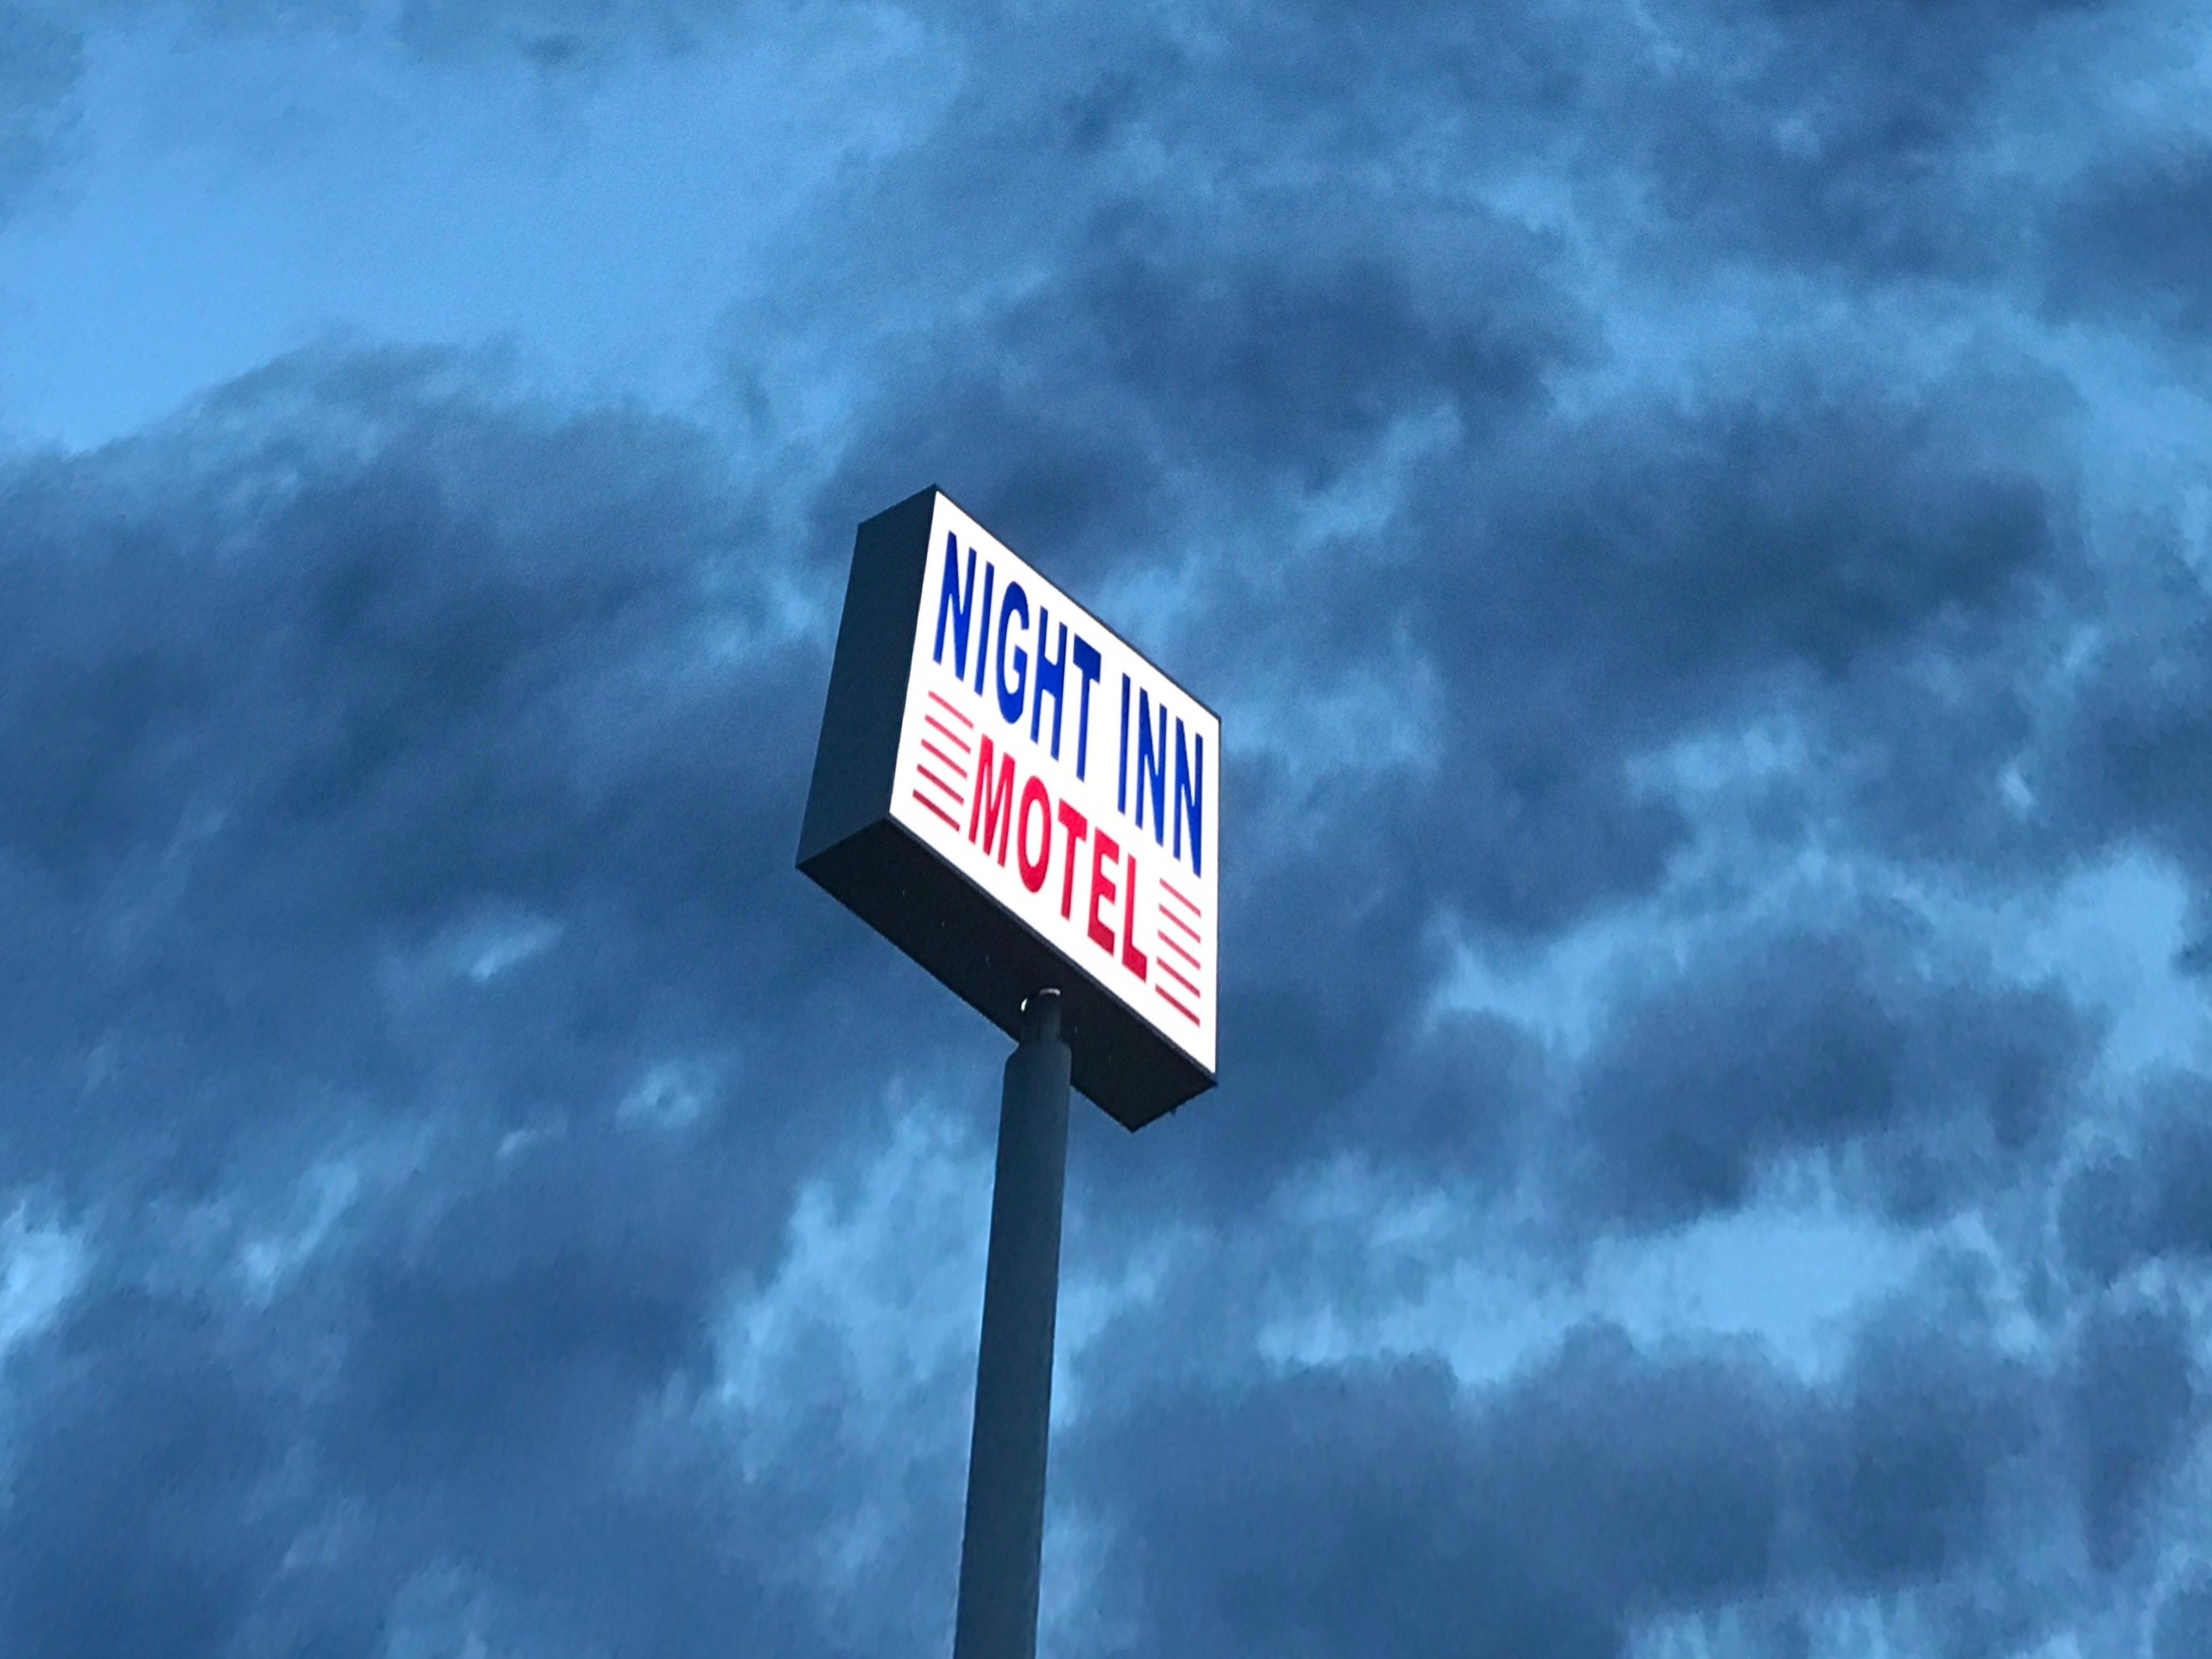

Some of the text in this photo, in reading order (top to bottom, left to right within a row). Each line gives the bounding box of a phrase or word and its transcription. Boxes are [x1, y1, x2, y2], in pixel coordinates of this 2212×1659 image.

[933, 531, 1203, 878] NIGHT INN
[968, 734, 1147, 983] MOTEL
